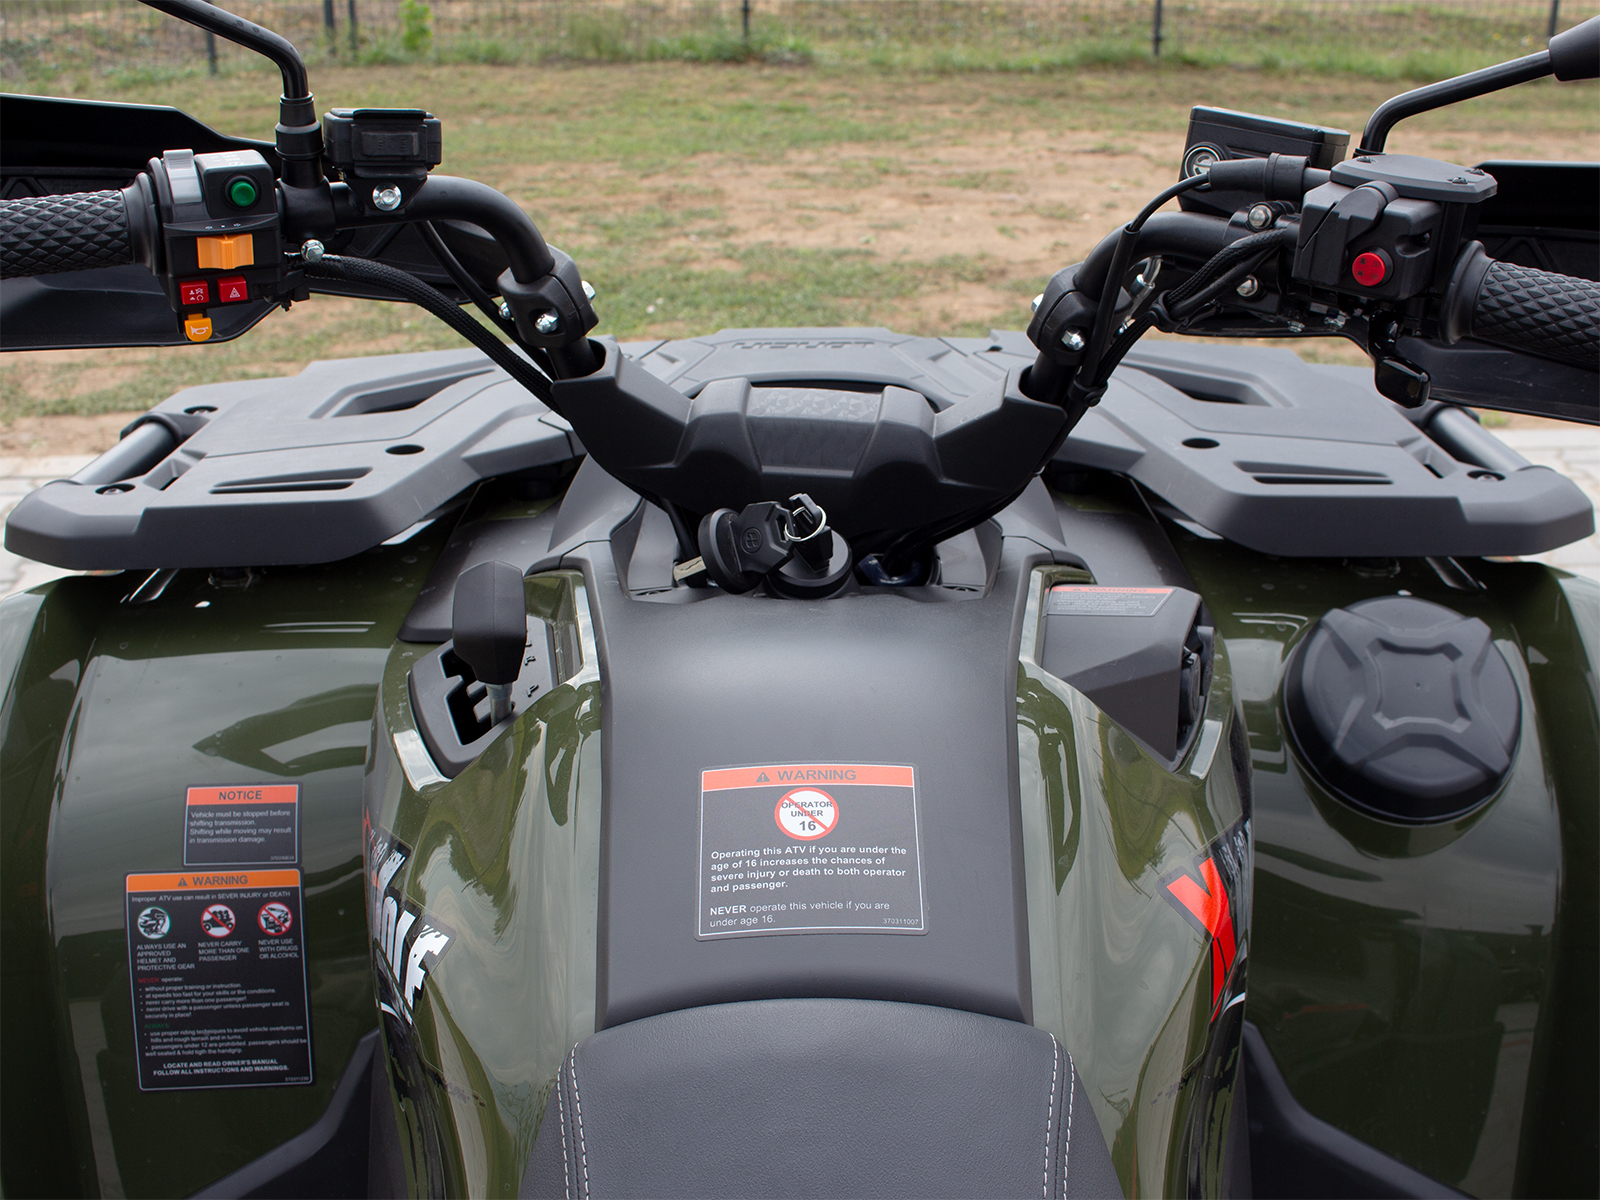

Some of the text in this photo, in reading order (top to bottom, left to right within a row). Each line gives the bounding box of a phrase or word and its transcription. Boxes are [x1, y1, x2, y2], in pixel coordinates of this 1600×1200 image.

[778, 770, 856, 781] WARNING
[219, 790, 262, 800] NOTICE
[781, 801, 833, 809] OPERATOR
[799, 820, 817, 831] 16
[711, 849, 760, 860] Operating
[763, 847, 782, 855] this
[711, 863, 729, 872] age
[732, 860, 742, 868] of
[193, 875, 248, 886] WARNING
[711, 873, 744, 881] severe
[747, 870, 776, 880] injury
[711, 881, 788, 892] and passenger.
[710, 905, 746, 915] NEVER
[750, 903, 787, 913] operate
[790, 902, 807, 910] this
[810, 901, 843, 909] vehicle
[854, 903, 872, 911] you
[710, 914, 775, 927] under age 16.
